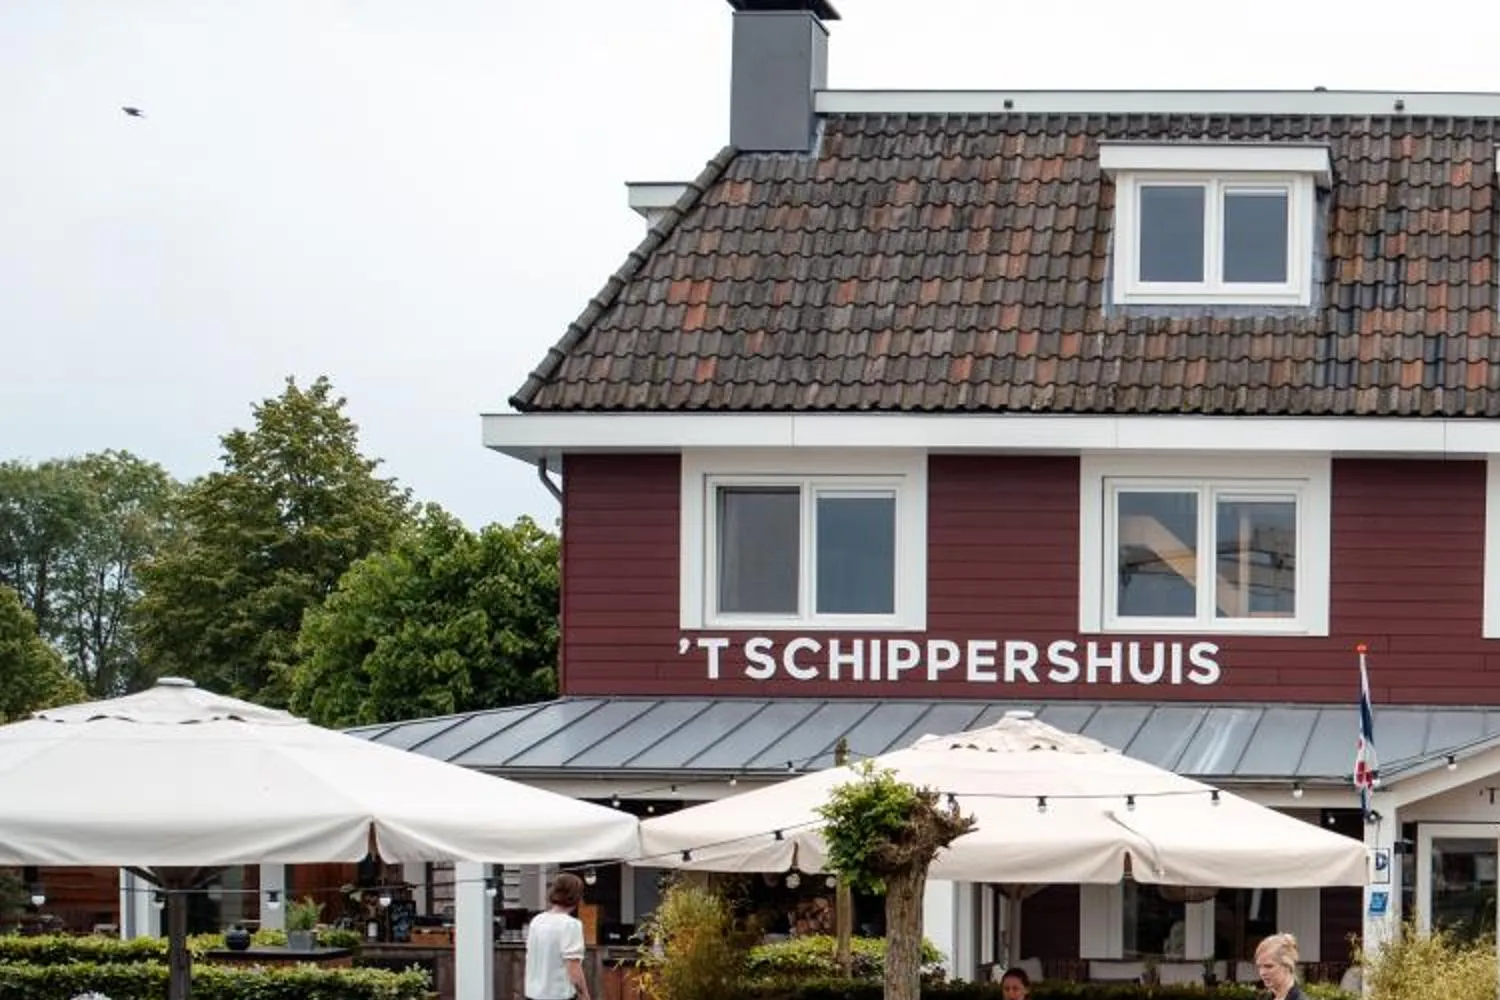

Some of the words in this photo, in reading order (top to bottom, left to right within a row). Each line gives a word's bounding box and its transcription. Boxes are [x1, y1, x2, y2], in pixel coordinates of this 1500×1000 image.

[679, 637, 730, 680] 'T
[743, 636, 1222, 686] SCHIPPERSHUIS
[1479, 786, 1499, 805] 'T
